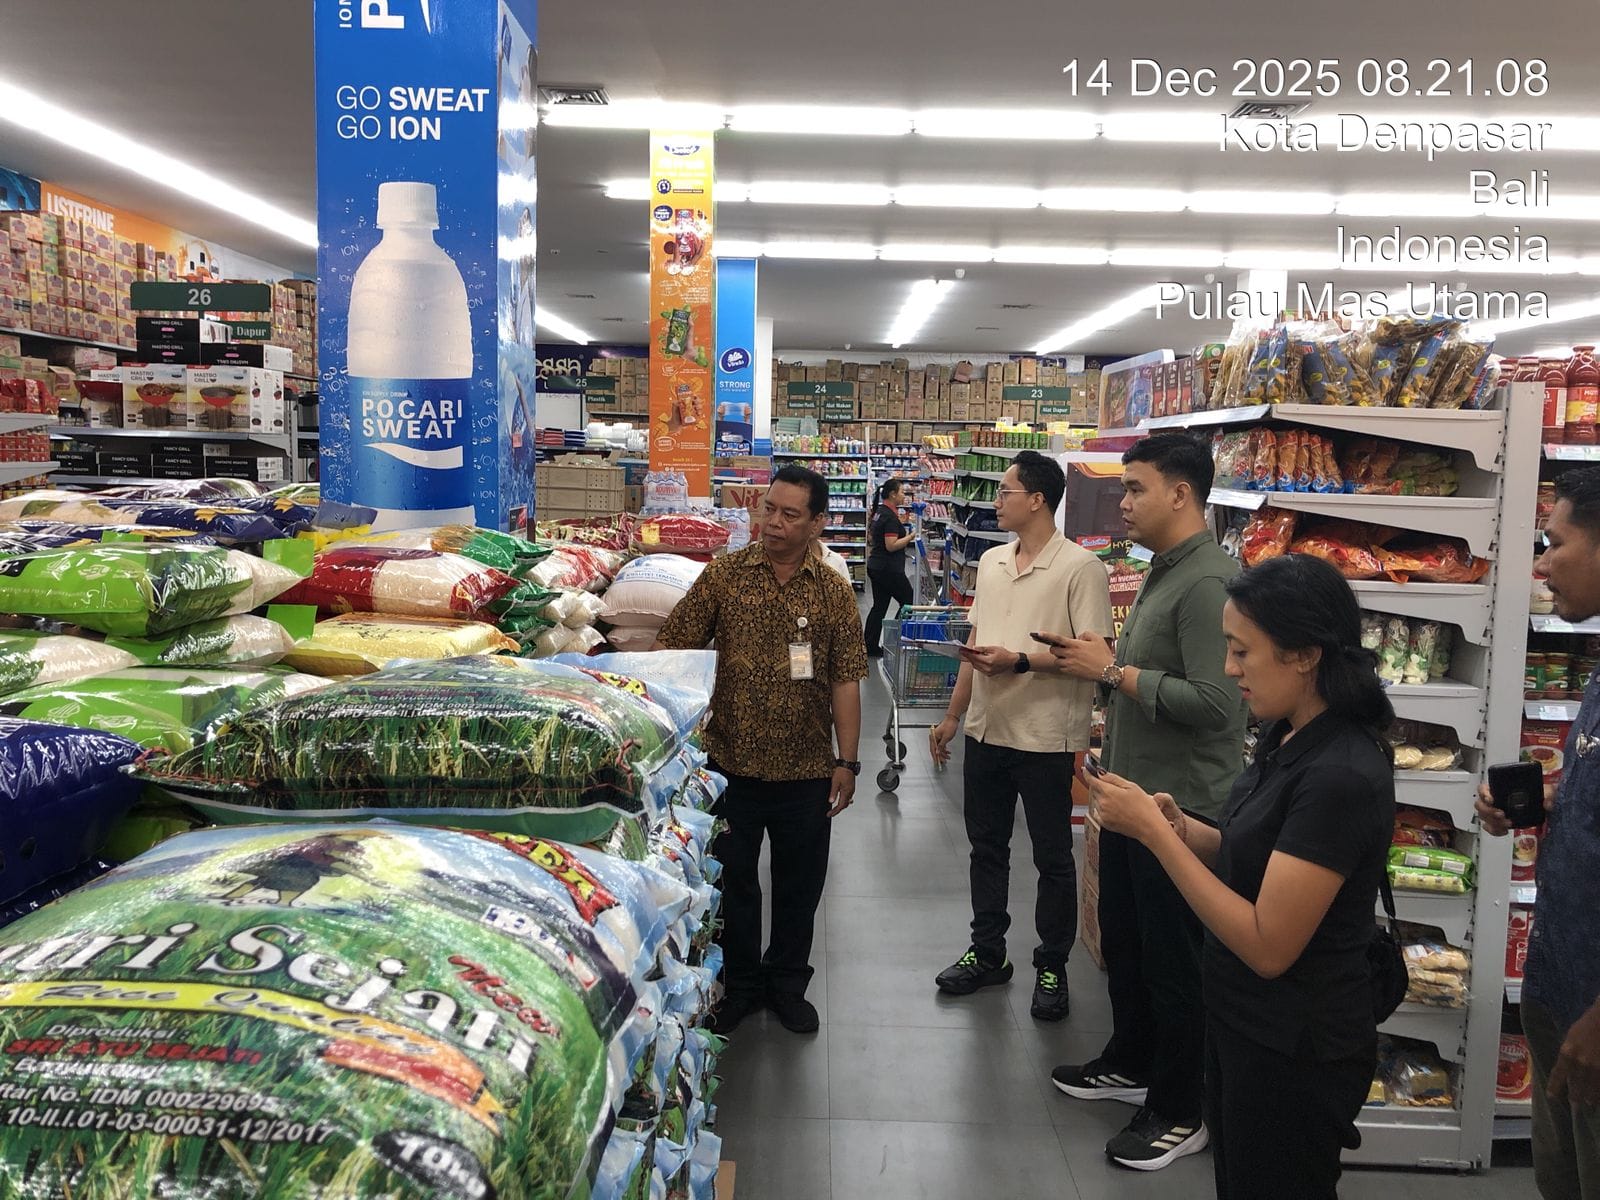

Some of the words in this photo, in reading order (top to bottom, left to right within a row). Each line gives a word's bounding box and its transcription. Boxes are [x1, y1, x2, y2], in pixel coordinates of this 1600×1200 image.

[336, 85, 381, 110] GO
[388, 86, 490, 112] SWEAT
[336, 115, 381, 140] GO
[389, 116, 441, 141] ION
[187, 287, 212, 307] 26
[236, 326, 267, 337] Dapur
[575, 378, 588, 387] 25
[719, 381, 751, 389] STRONG
[814, 384, 827, 394] 24
[1031, 389, 1043, 398] 23
[362, 398, 463, 419] POCARI
[362, 419, 456, 439] SWEAT
[731, 487, 764, 509] Vit
[46, 1024, 177, 1039] Diproduksi
[7, 1039, 65, 1054] SRI
[67, 1041, 141, 1057] AYU
[41, 1086, 81, 1102] No.
[89, 1088, 142, 1105] IDM
